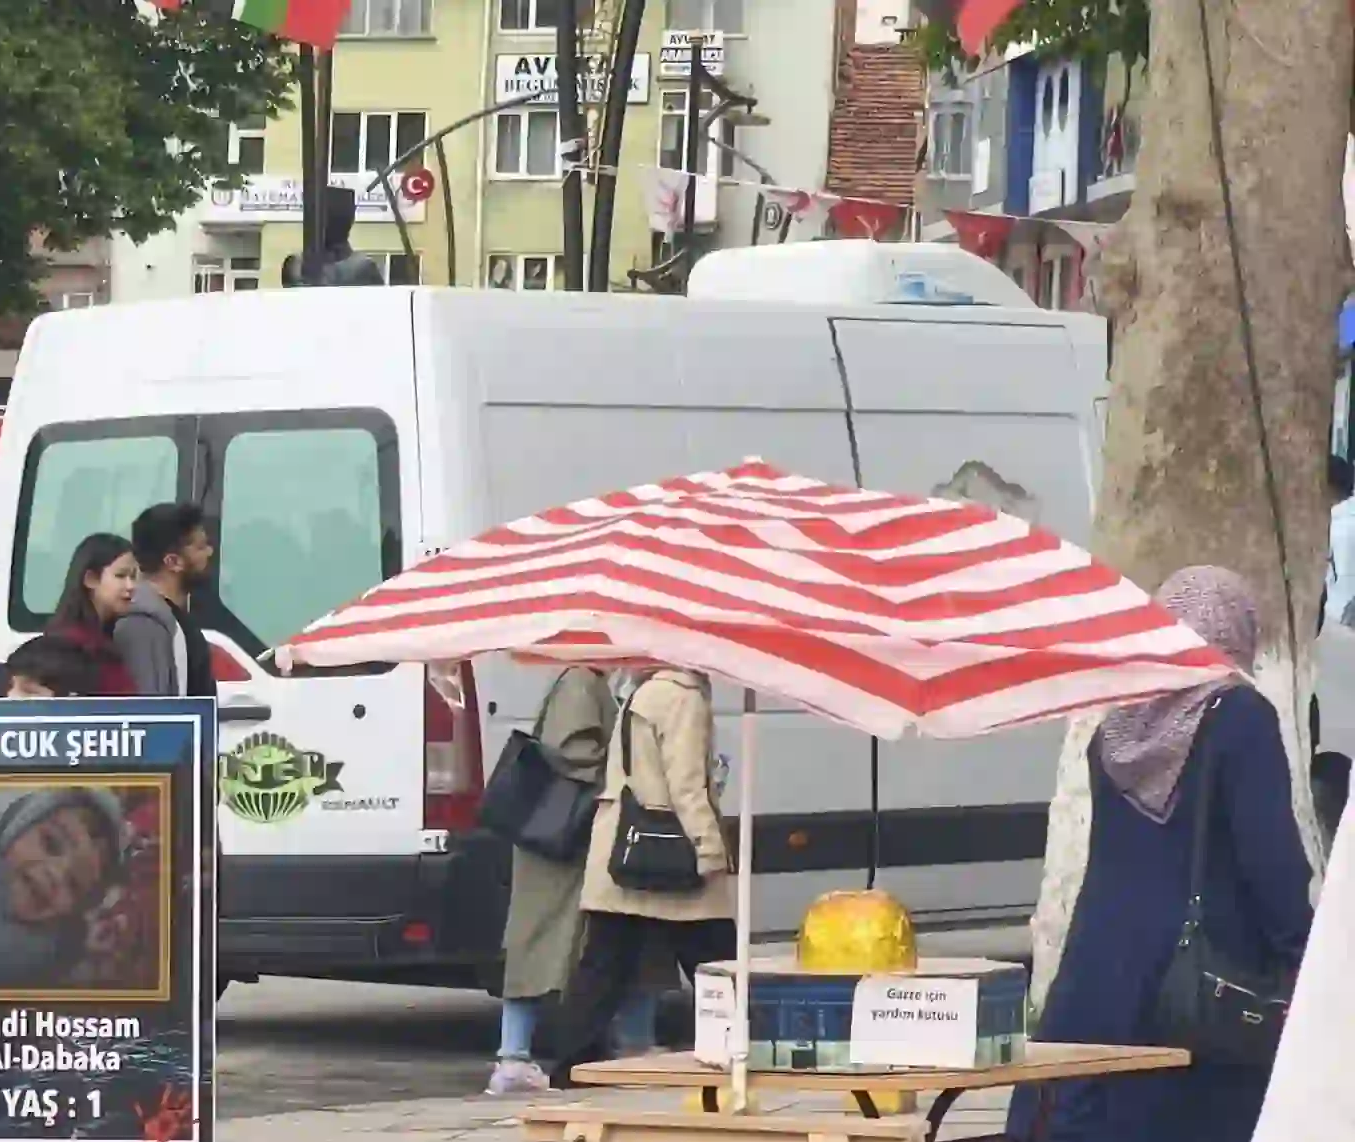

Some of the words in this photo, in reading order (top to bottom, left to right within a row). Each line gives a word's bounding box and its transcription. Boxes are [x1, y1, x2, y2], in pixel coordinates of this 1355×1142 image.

[66, 722, 147, 766] ŞEHİT
[35, 1010, 140, 1039] Hossam
[2, 1088, 58, 1126] YAŞ
[86, 1089, 103, 1118] 1
